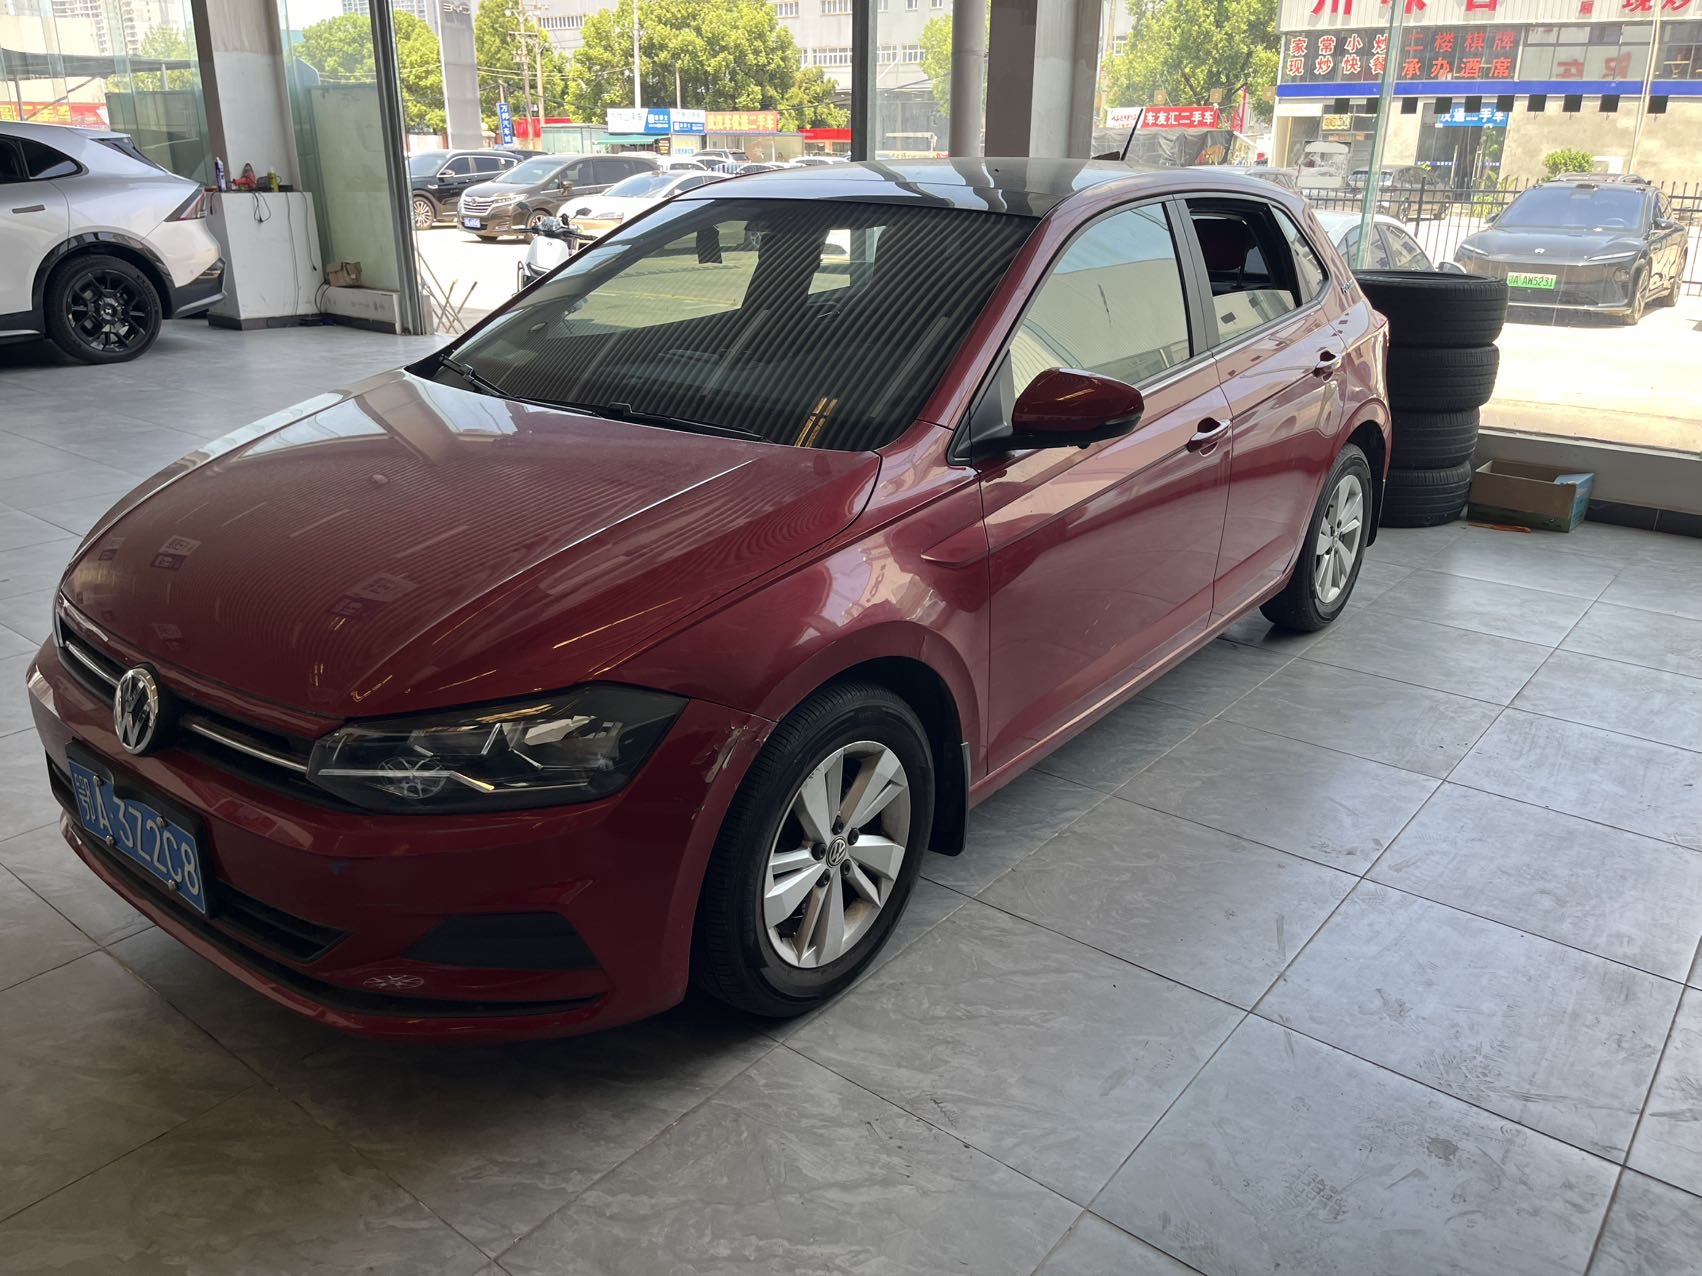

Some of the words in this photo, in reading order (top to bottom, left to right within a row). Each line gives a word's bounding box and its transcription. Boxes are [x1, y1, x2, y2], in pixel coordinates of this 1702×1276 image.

[1290, 34, 1388, 56] 家常小炒
[1405, 31, 1515, 52] 二楼棋牌
[1286, 54, 1387, 76] 现炒快餐
[1402, 57, 1512, 78] 承办酒席
[1145, 111, 1214, 125] 车友汇二手车
